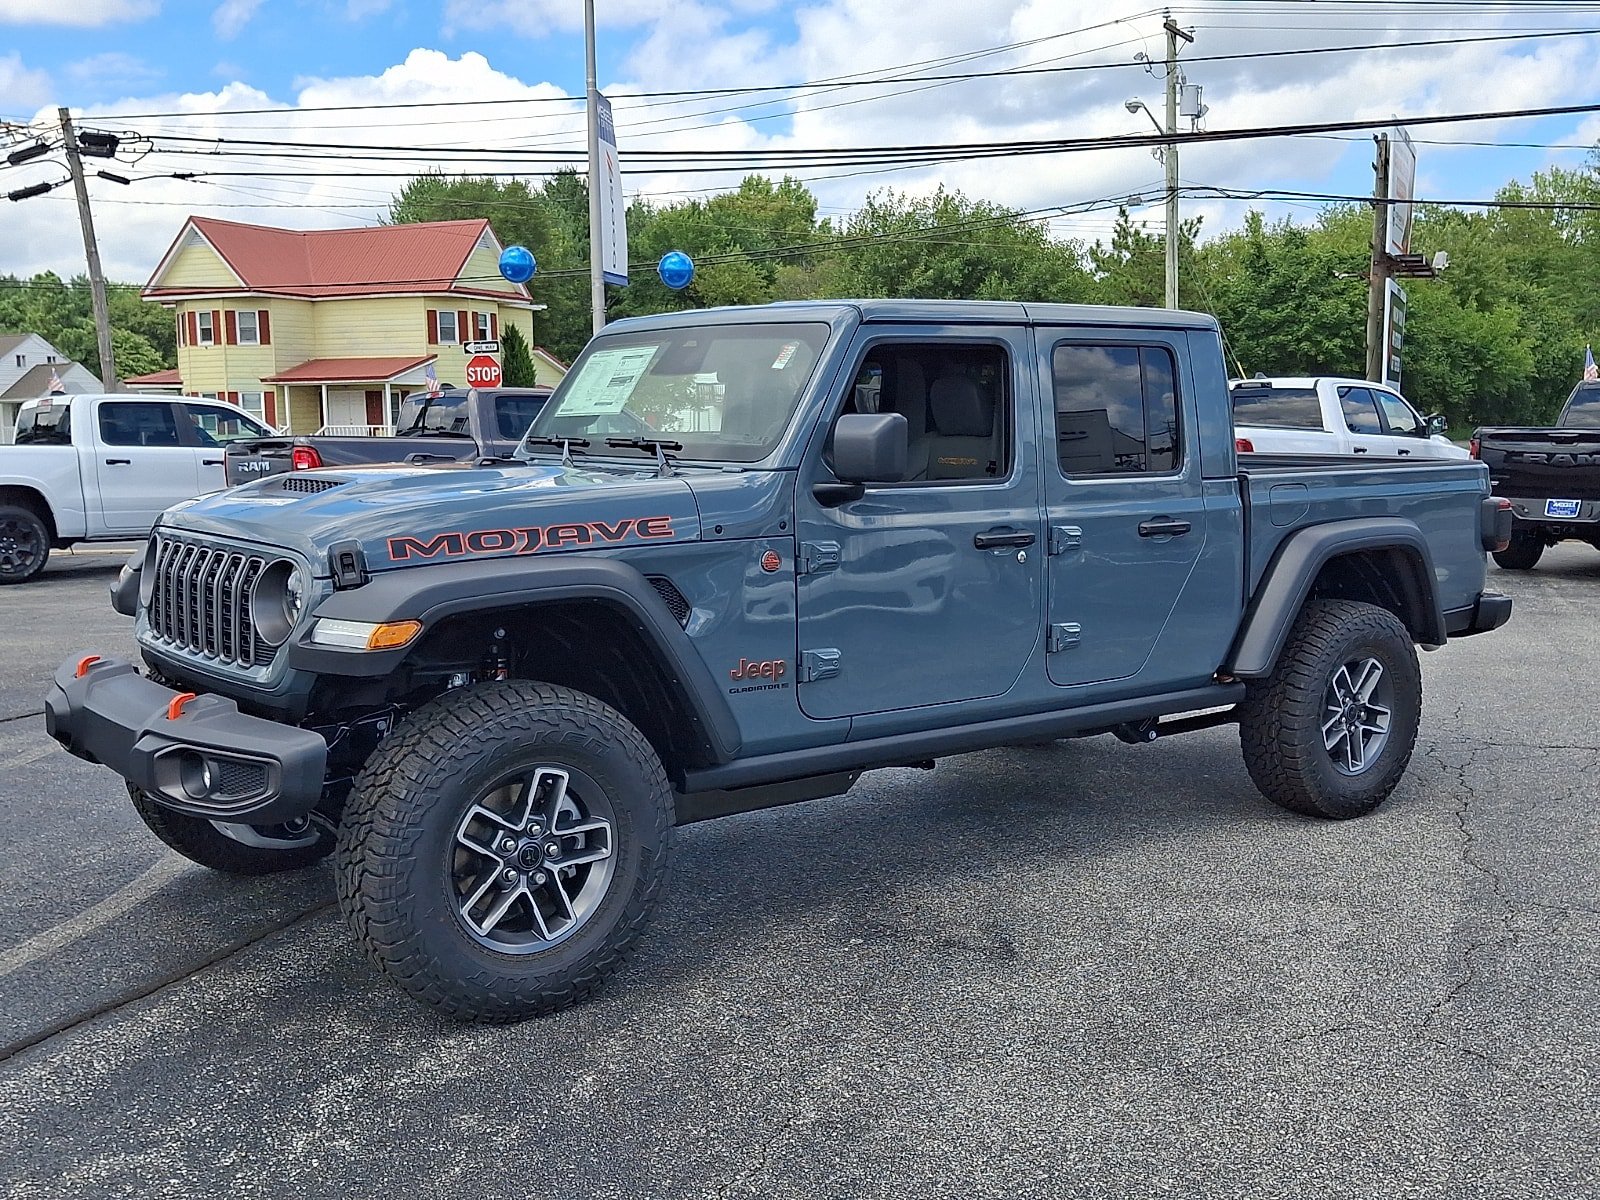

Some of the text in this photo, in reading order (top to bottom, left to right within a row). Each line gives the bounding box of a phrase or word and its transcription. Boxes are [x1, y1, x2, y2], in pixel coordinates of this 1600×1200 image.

[467, 367, 500, 382] STOP
[238, 461, 270, 472] RAM
[1510, 453, 1600, 466] RAM
[387, 516, 674, 560] MOJAVE
[730, 658, 787, 682] Jeep
[728, 683, 782, 695] GLADIATOR
